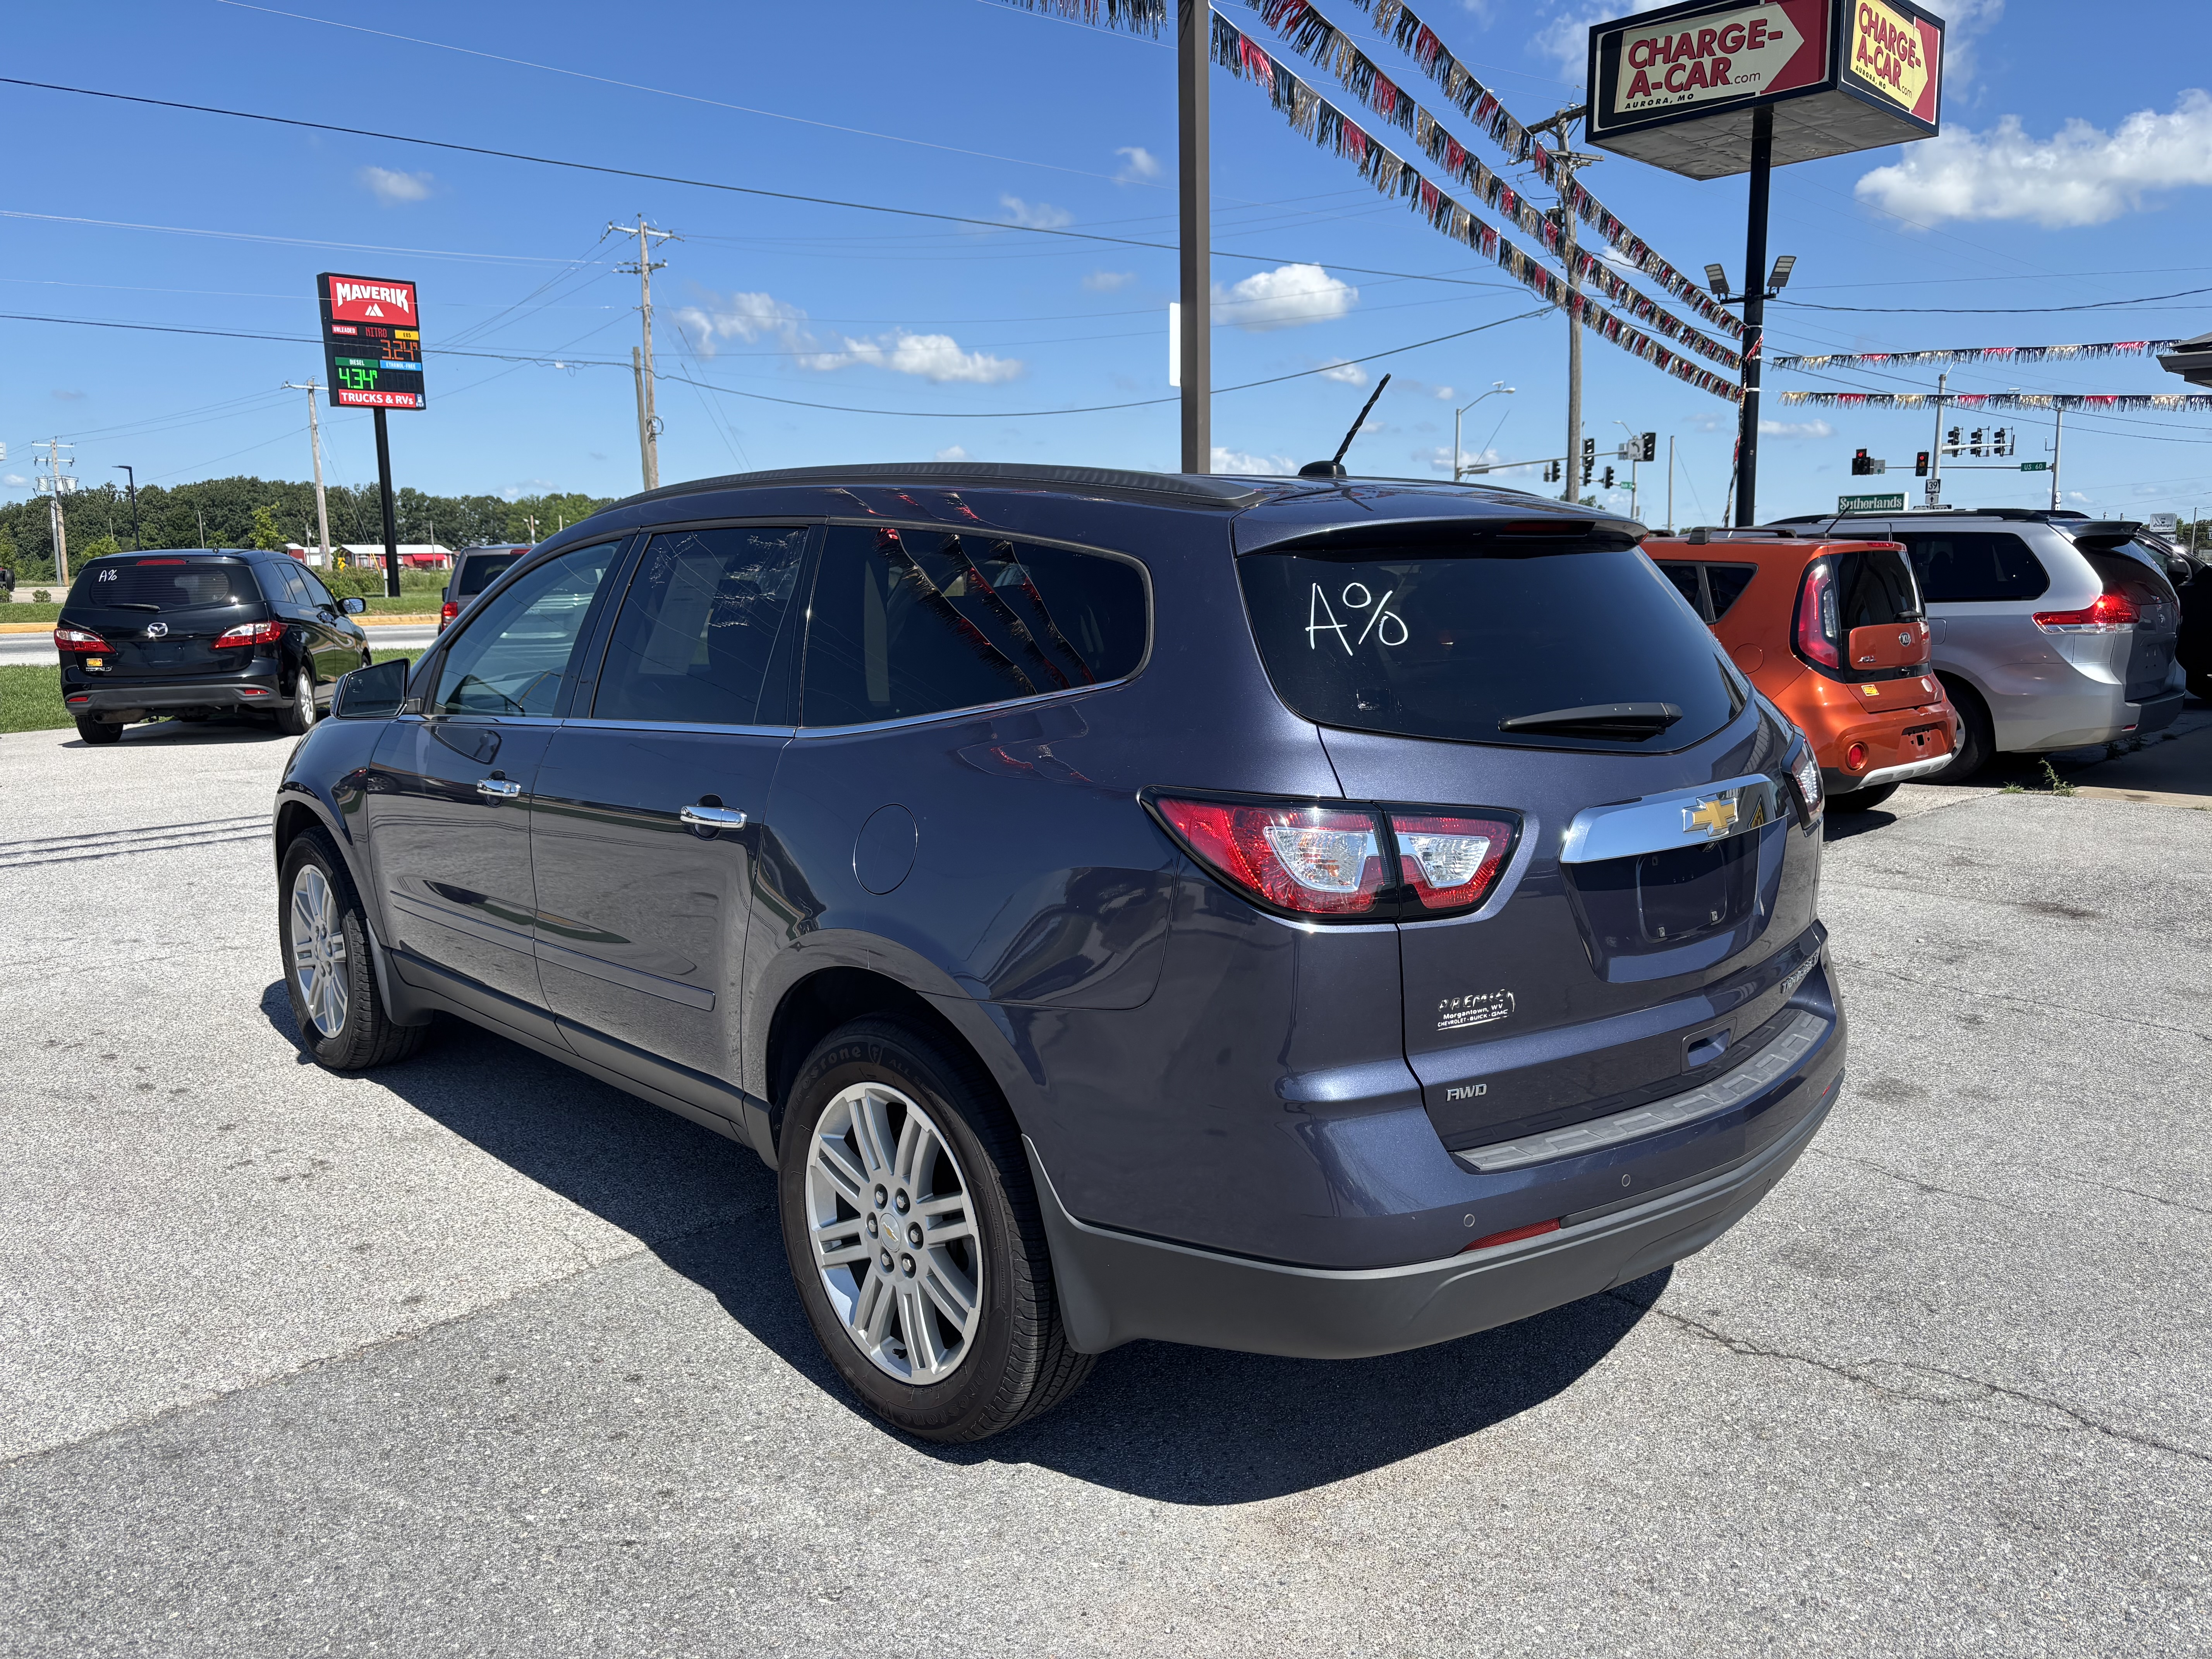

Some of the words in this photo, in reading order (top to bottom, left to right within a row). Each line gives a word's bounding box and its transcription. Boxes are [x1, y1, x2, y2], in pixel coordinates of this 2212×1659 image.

[1859, 2, 1921, 69] CHARGE-
[1628, 18, 1783, 69] CHARGE-
[1855, 65, 1877, 85] AURORA,
[1879, 80, 1886, 89] MO
[1625, 97, 1673, 109] AURORA,
[1677, 93, 1694, 101] MO
[336, 282, 409, 314] MAVERIK
[365, 327, 387, 338] NITRO
[341, 392, 383, 404] TRUCKS
[385, 395, 393, 404] &
[395, 395, 414, 405] RVs
[1928, 481, 1937, 489] 39
[1840, 496, 1902, 510] Sutherlands
[1443, 1008, 1489, 1020] Morgantown,
[1437, 1017, 1466, 1027] CHEVROLET
[1446, 1084, 1487, 1102] AWD
